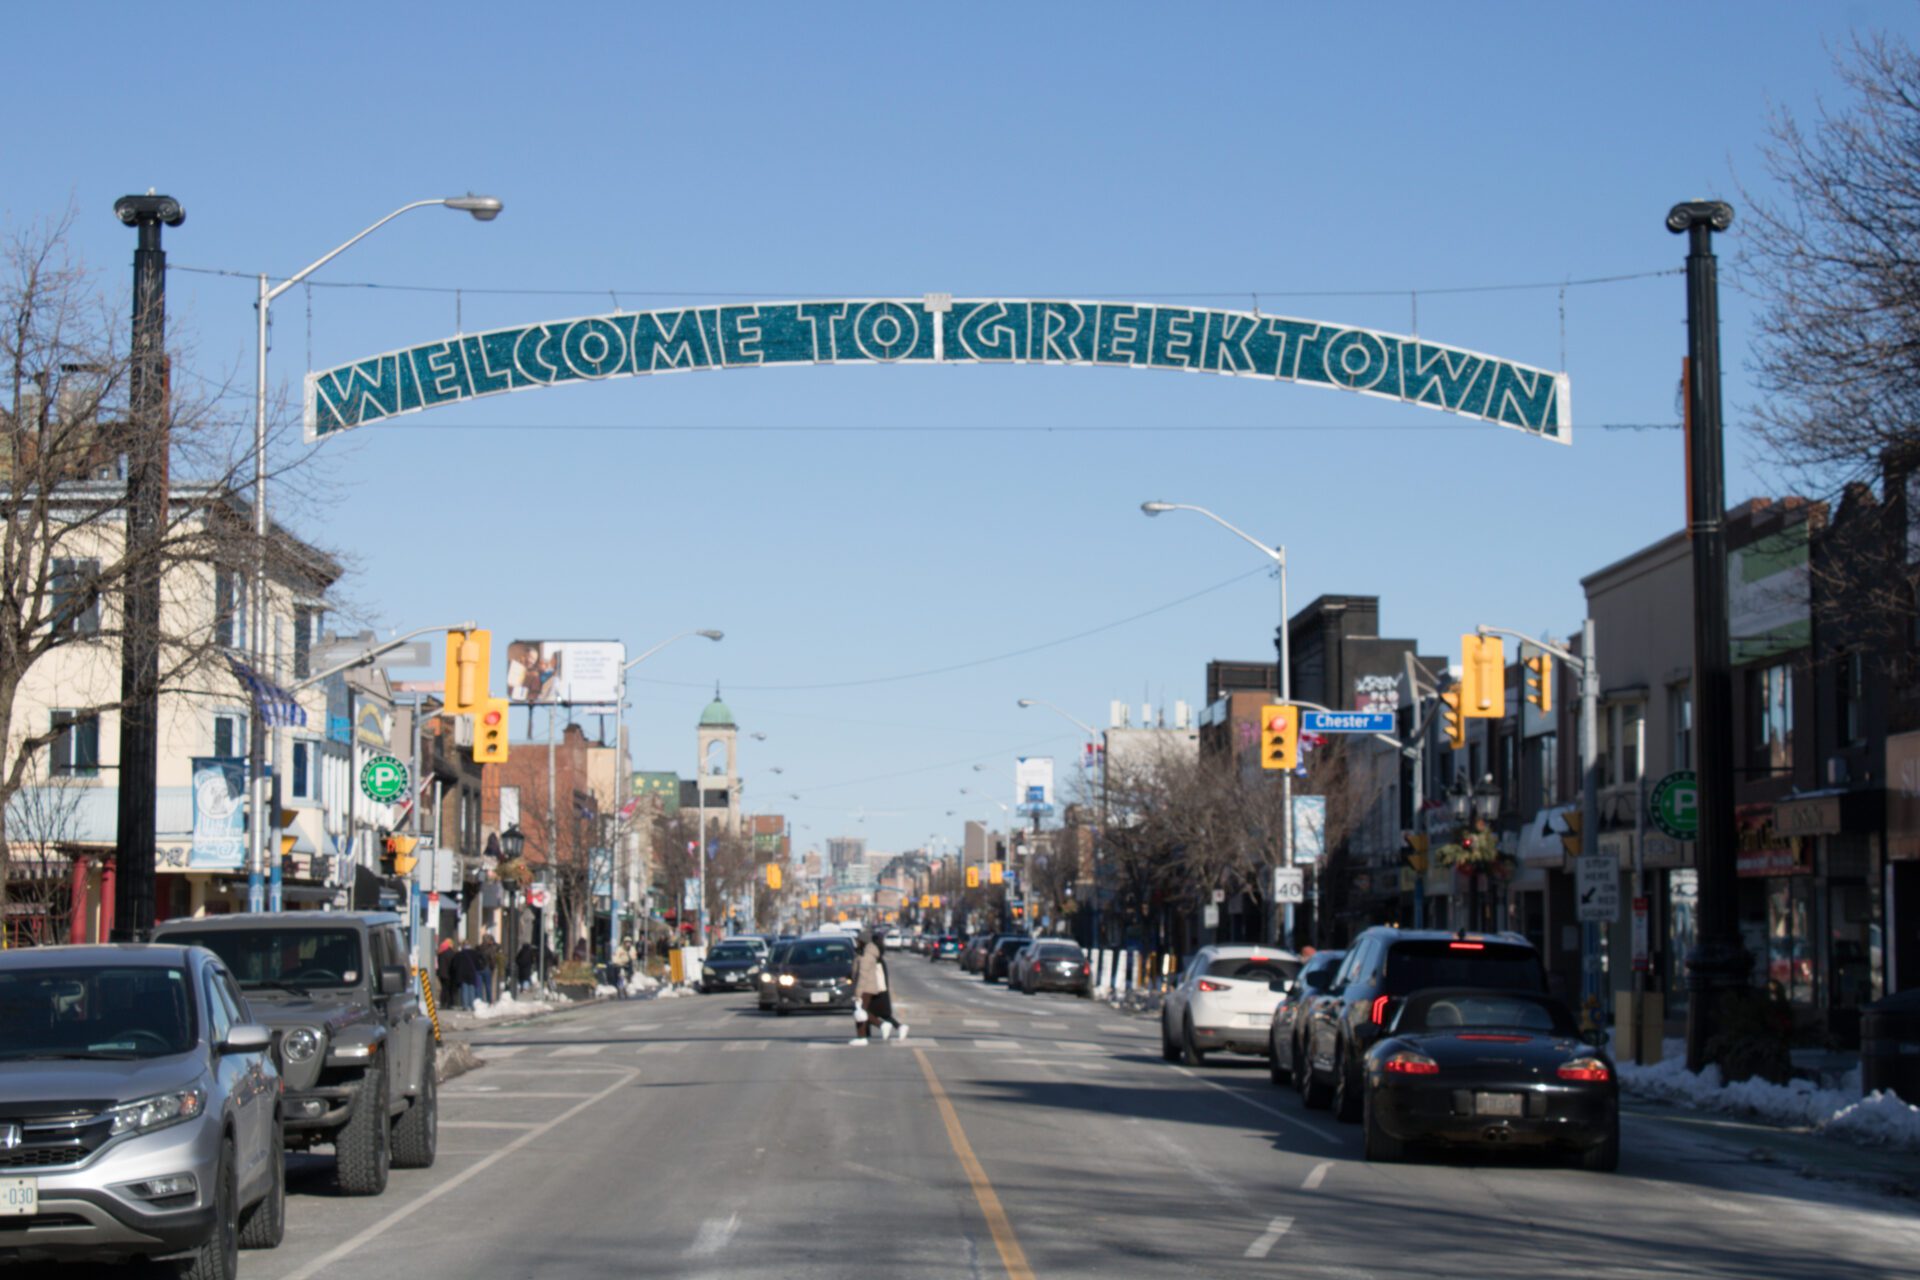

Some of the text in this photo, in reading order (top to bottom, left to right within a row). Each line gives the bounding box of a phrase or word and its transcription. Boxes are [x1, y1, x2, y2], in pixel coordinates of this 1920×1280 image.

[313, 300, 1560, 437] WELCOME TO GREEKTOWN
[1316, 714, 1370, 728] Chester
[375, 767, 394, 787] P
[1674, 789, 1697, 815] P
[1278, 882, 1302, 897] 40
